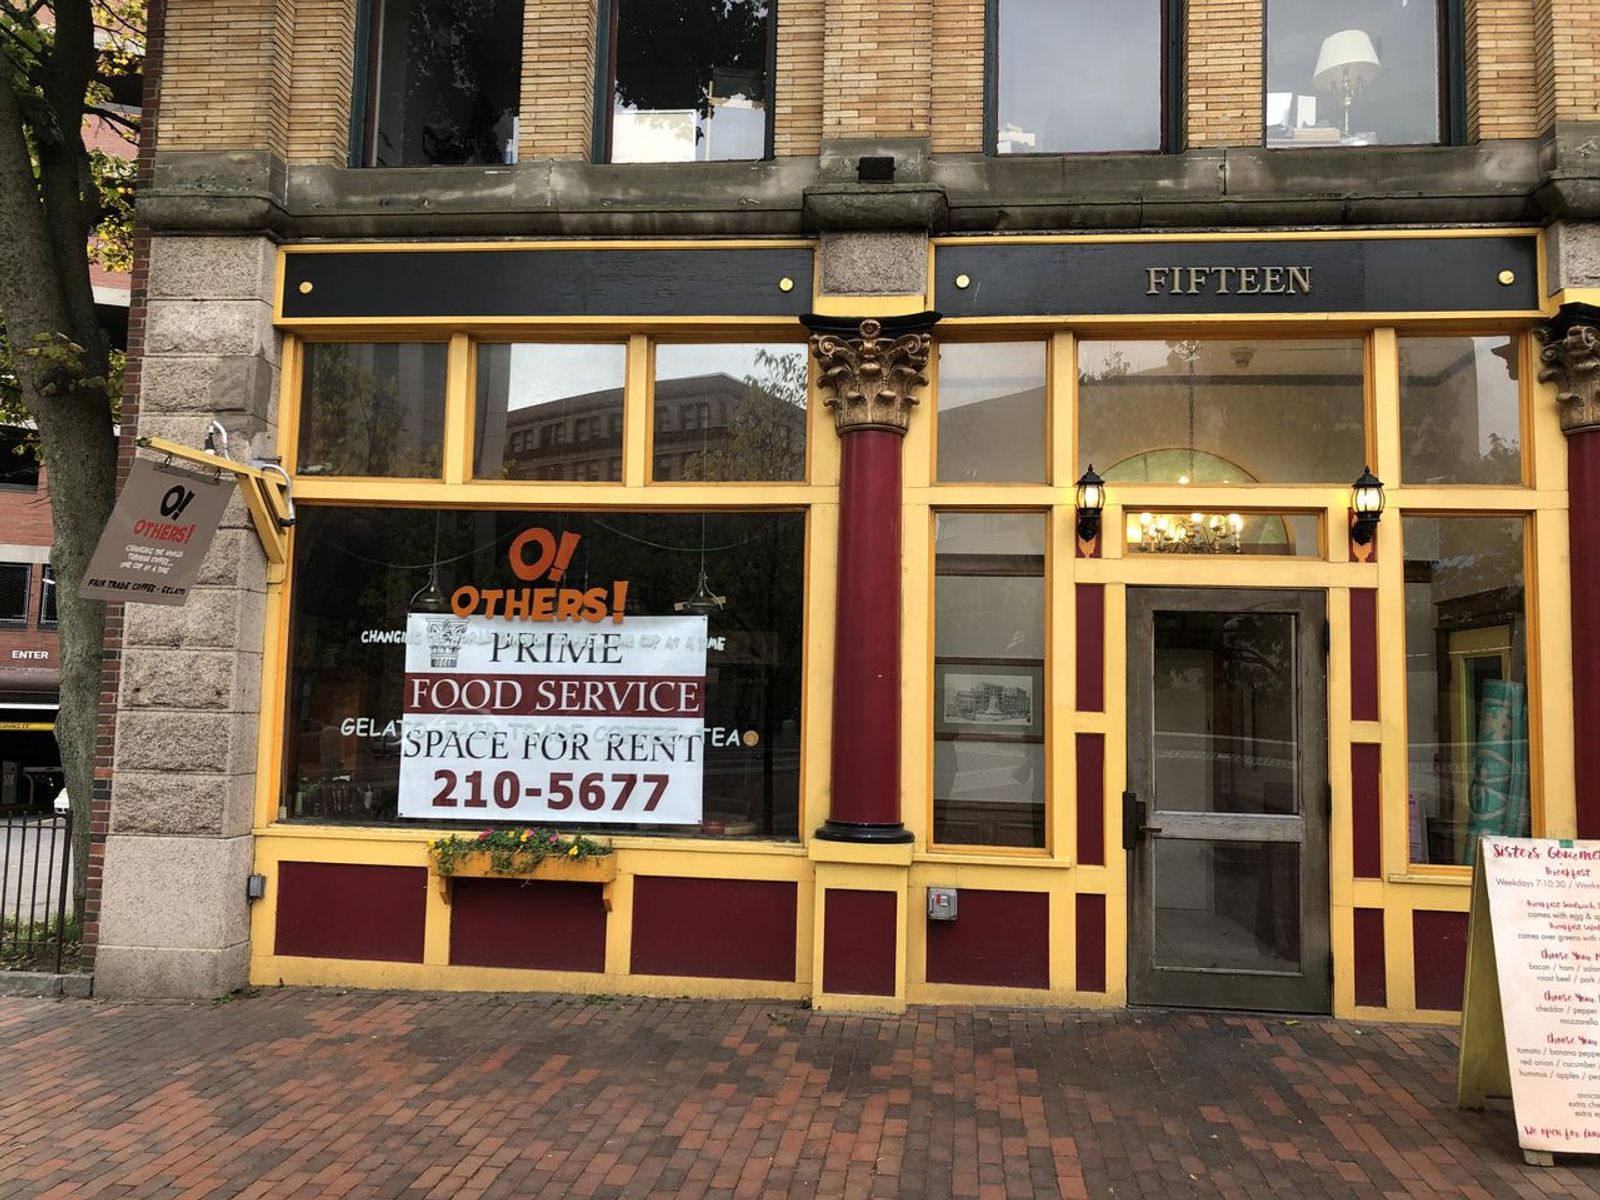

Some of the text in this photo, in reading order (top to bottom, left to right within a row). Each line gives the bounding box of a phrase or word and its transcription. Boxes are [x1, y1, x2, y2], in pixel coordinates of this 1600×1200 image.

[1145, 266, 1312, 295] FIFTEEN
[161, 485, 195, 521] O!
[133, 519, 197, 545] OTHERS!
[509, 528, 581, 581] O!
[88, 578, 187, 595] FAIR TRADE COFFEE GELATO
[451, 580, 629, 624] OTHERS!
[489, 632, 623, 664] PRIME
[12, 650, 49, 660] ENTER
[410, 678, 700, 713] FOOD SERVICE
[404, 730, 702, 764] SPACE FOR RENT
[432, 769, 670, 812] 210-5677
[1493, 843, 1540, 859] Sisters
[1545, 866, 1591, 879] Breakfast
[1496, 878, 1534, 889] Weekdays
[1552, 911, 1568, 919] with
[1569, 913, 1584, 922] egg
[1557, 935, 1581, 943] greens
[1528, 962, 1551, 970] bacon
[1558, 963, 1575, 971] ham
[1555, 974, 1571, 982] beef
[1535, 1004, 1564, 1013] cheddar
[1560, 1018, 1599, 1026] mozzarella
[1517, 1047, 1541, 1055] tomato
[1549, 1047, 1577, 1056] banana
[1520, 1058, 1533, 1066] red
[1533, 1059, 1554, 1067] onion
[1562, 1060, 1596, 1069] cucumber
[1518, 1069, 1548, 1078] hummus
[1556, 1071, 1580, 1080] apples
